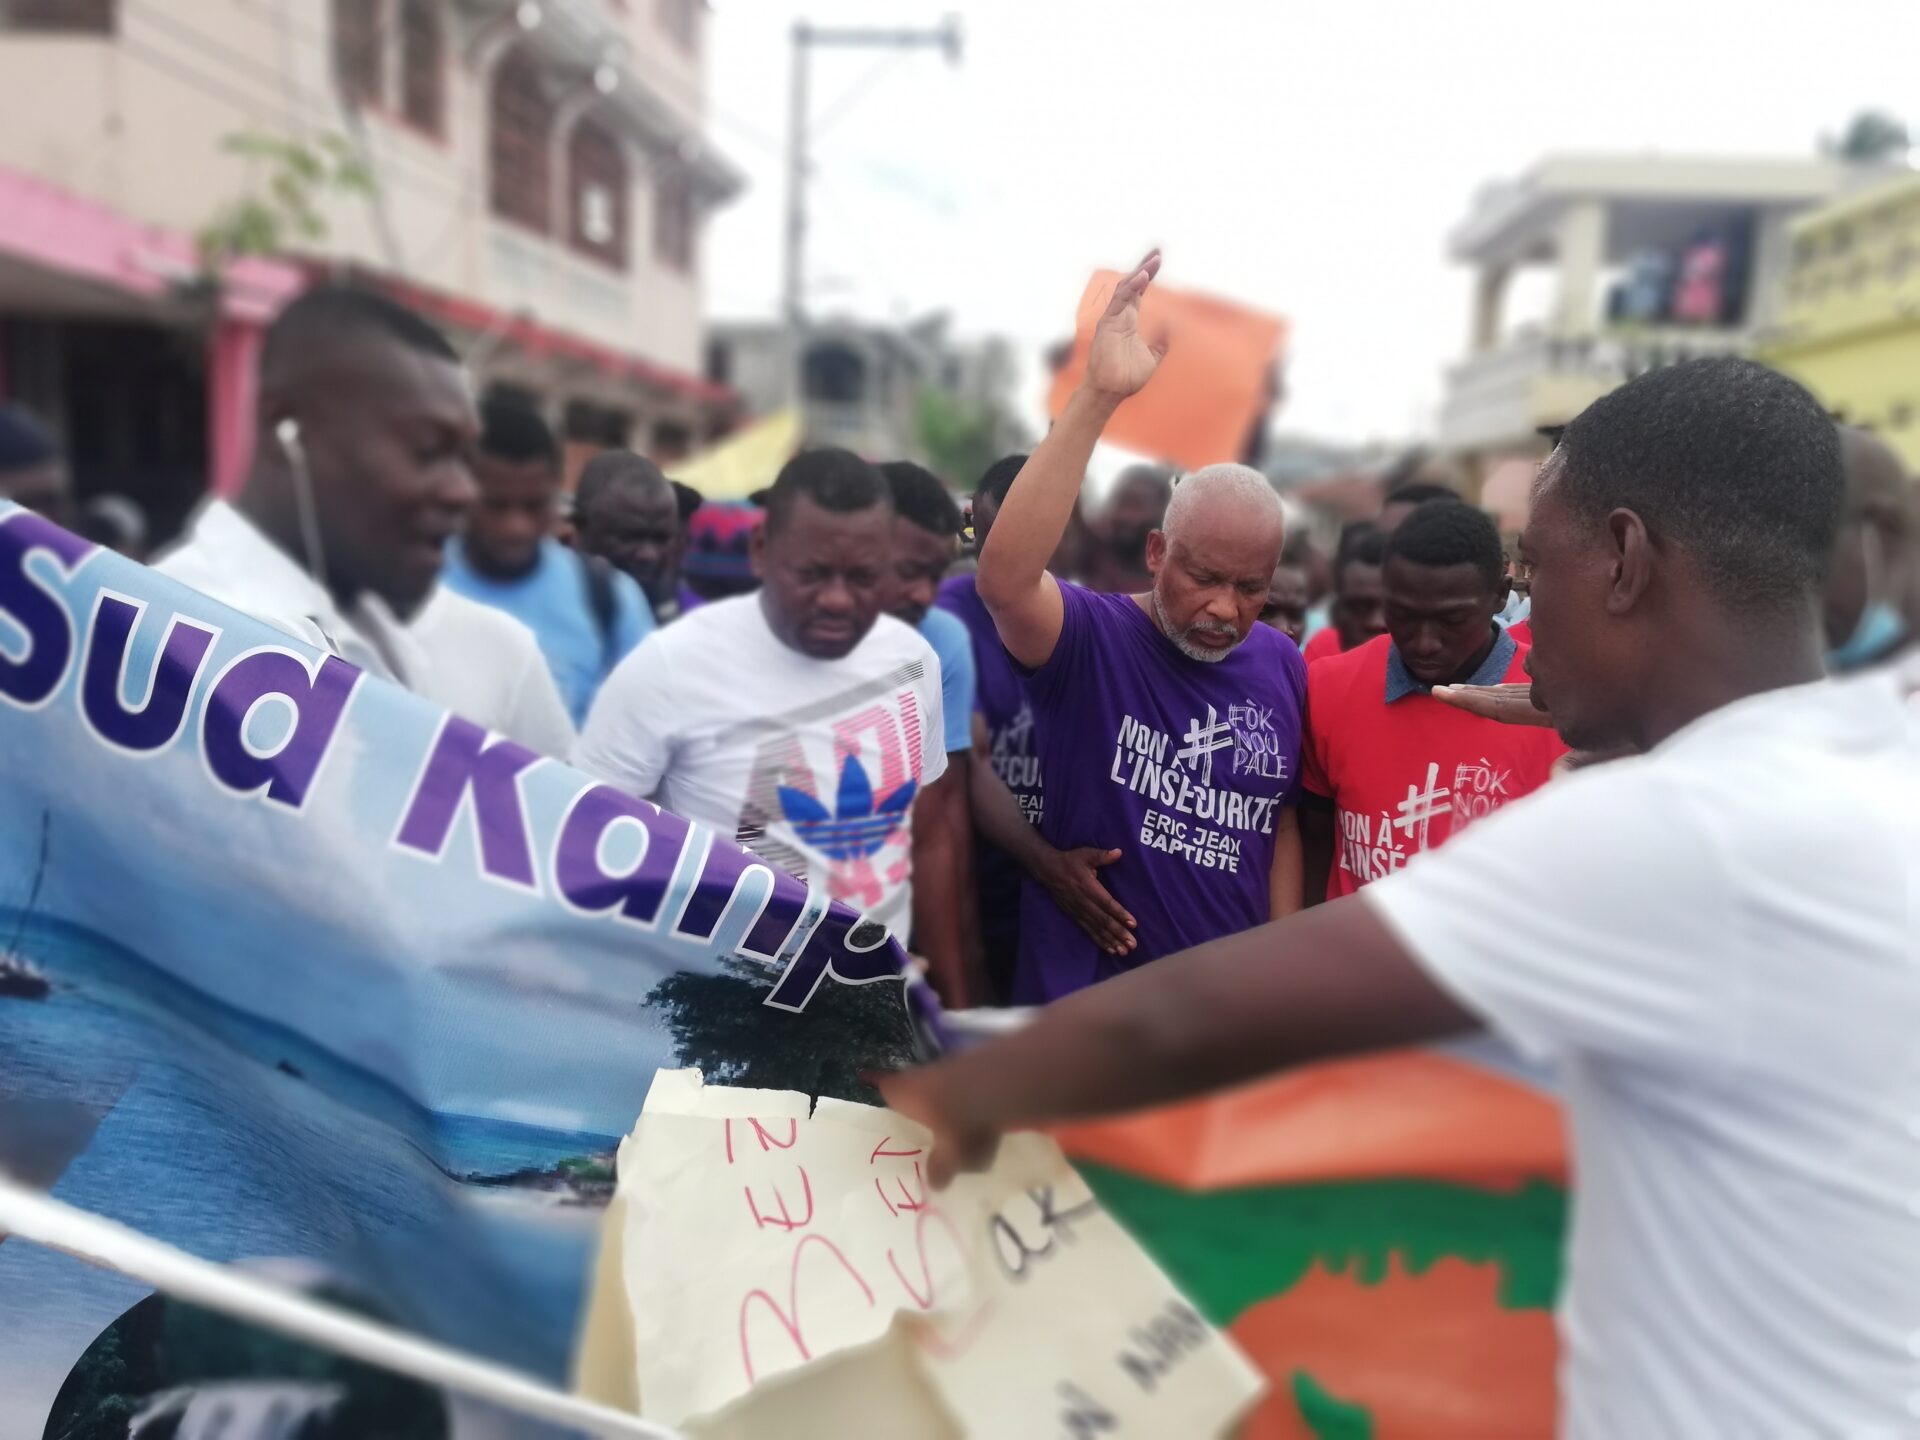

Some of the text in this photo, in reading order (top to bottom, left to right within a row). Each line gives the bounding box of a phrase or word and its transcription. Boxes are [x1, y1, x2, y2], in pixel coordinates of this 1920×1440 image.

[1117, 714, 1169, 764] NON
[1234, 728, 1279, 756] NOU
[1232, 748, 1289, 779] PALE
[1143, 808, 1188, 839] ERIC
[1140, 827, 1240, 874] BAPTISTE
